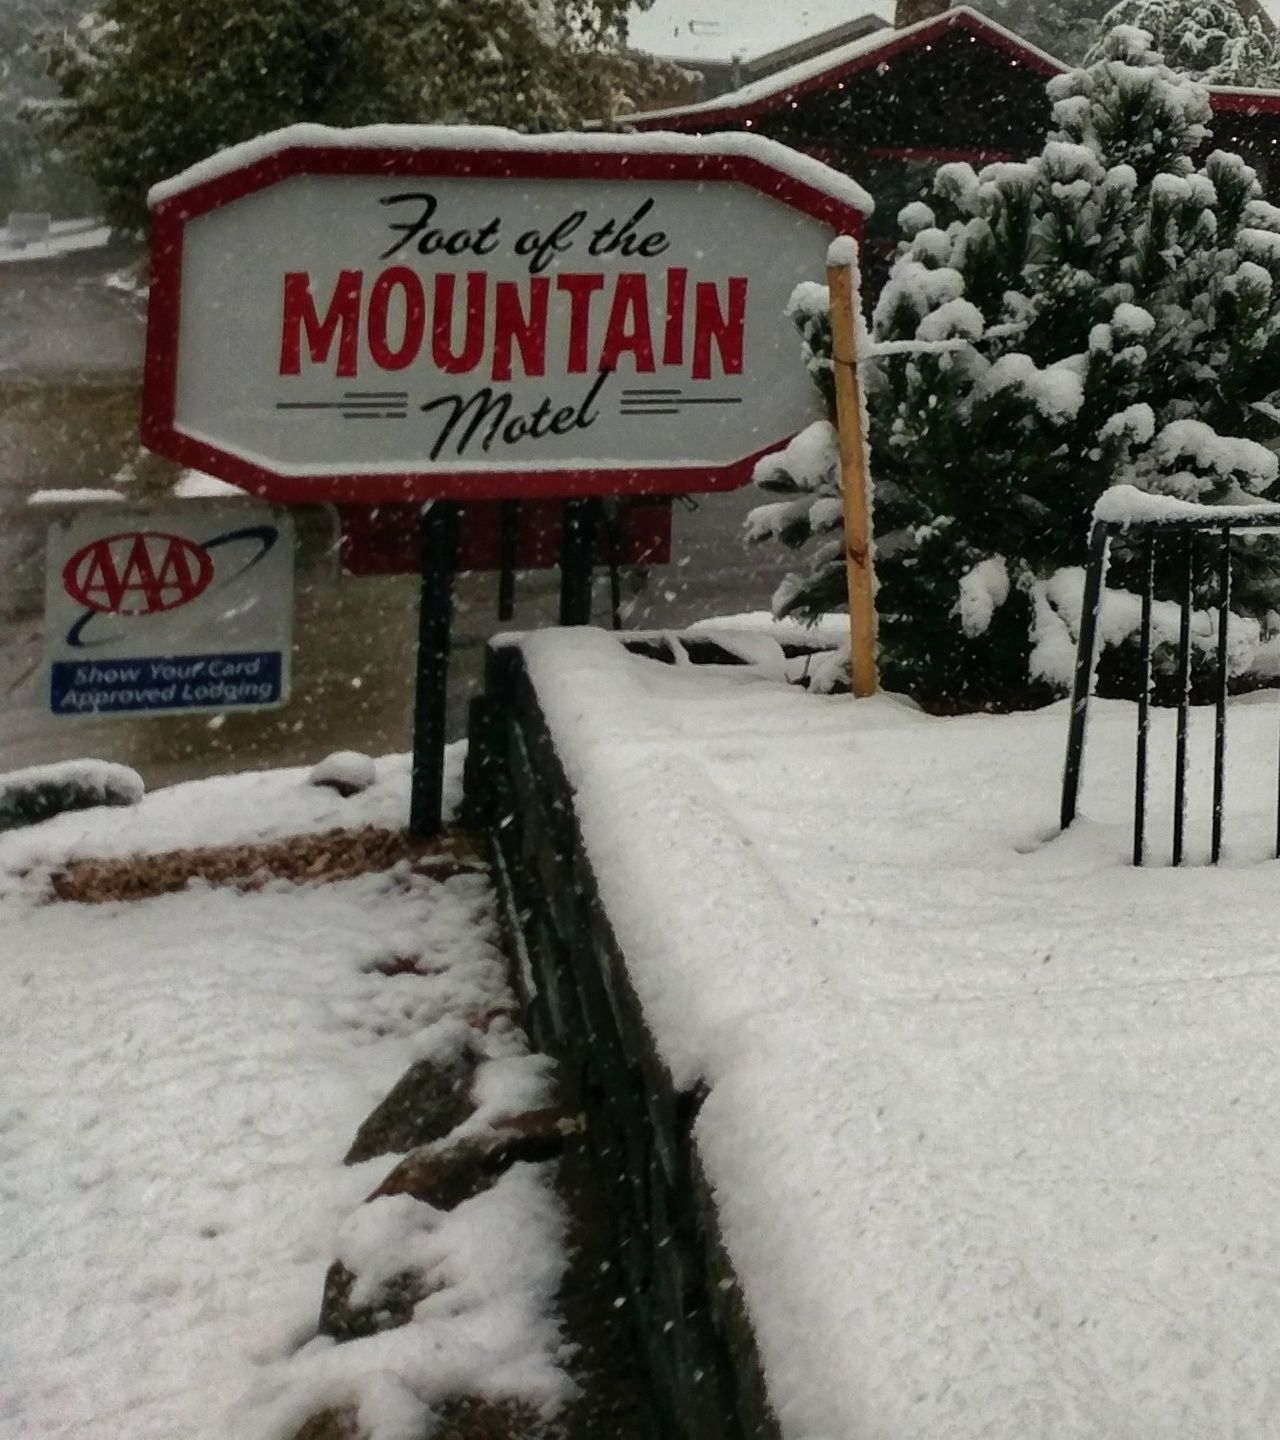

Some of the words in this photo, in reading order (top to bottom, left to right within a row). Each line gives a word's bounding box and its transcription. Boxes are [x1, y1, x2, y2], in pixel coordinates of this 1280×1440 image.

[378, 192, 501, 259] Foot
[515, 210, 588, 273] of
[588, 197, 670, 258] the
[279, 265, 748, 381] MOUNTAIN
[420, 367, 601, 461] Motel
[80, 531, 202, 614] AAA
[60, 684, 177, 713] Approved
[181, 679, 275, 703] Lodging
[74, 666, 142, 686] Show
[150, 662, 206, 680] Your
[207, 658, 262, 677] Card
